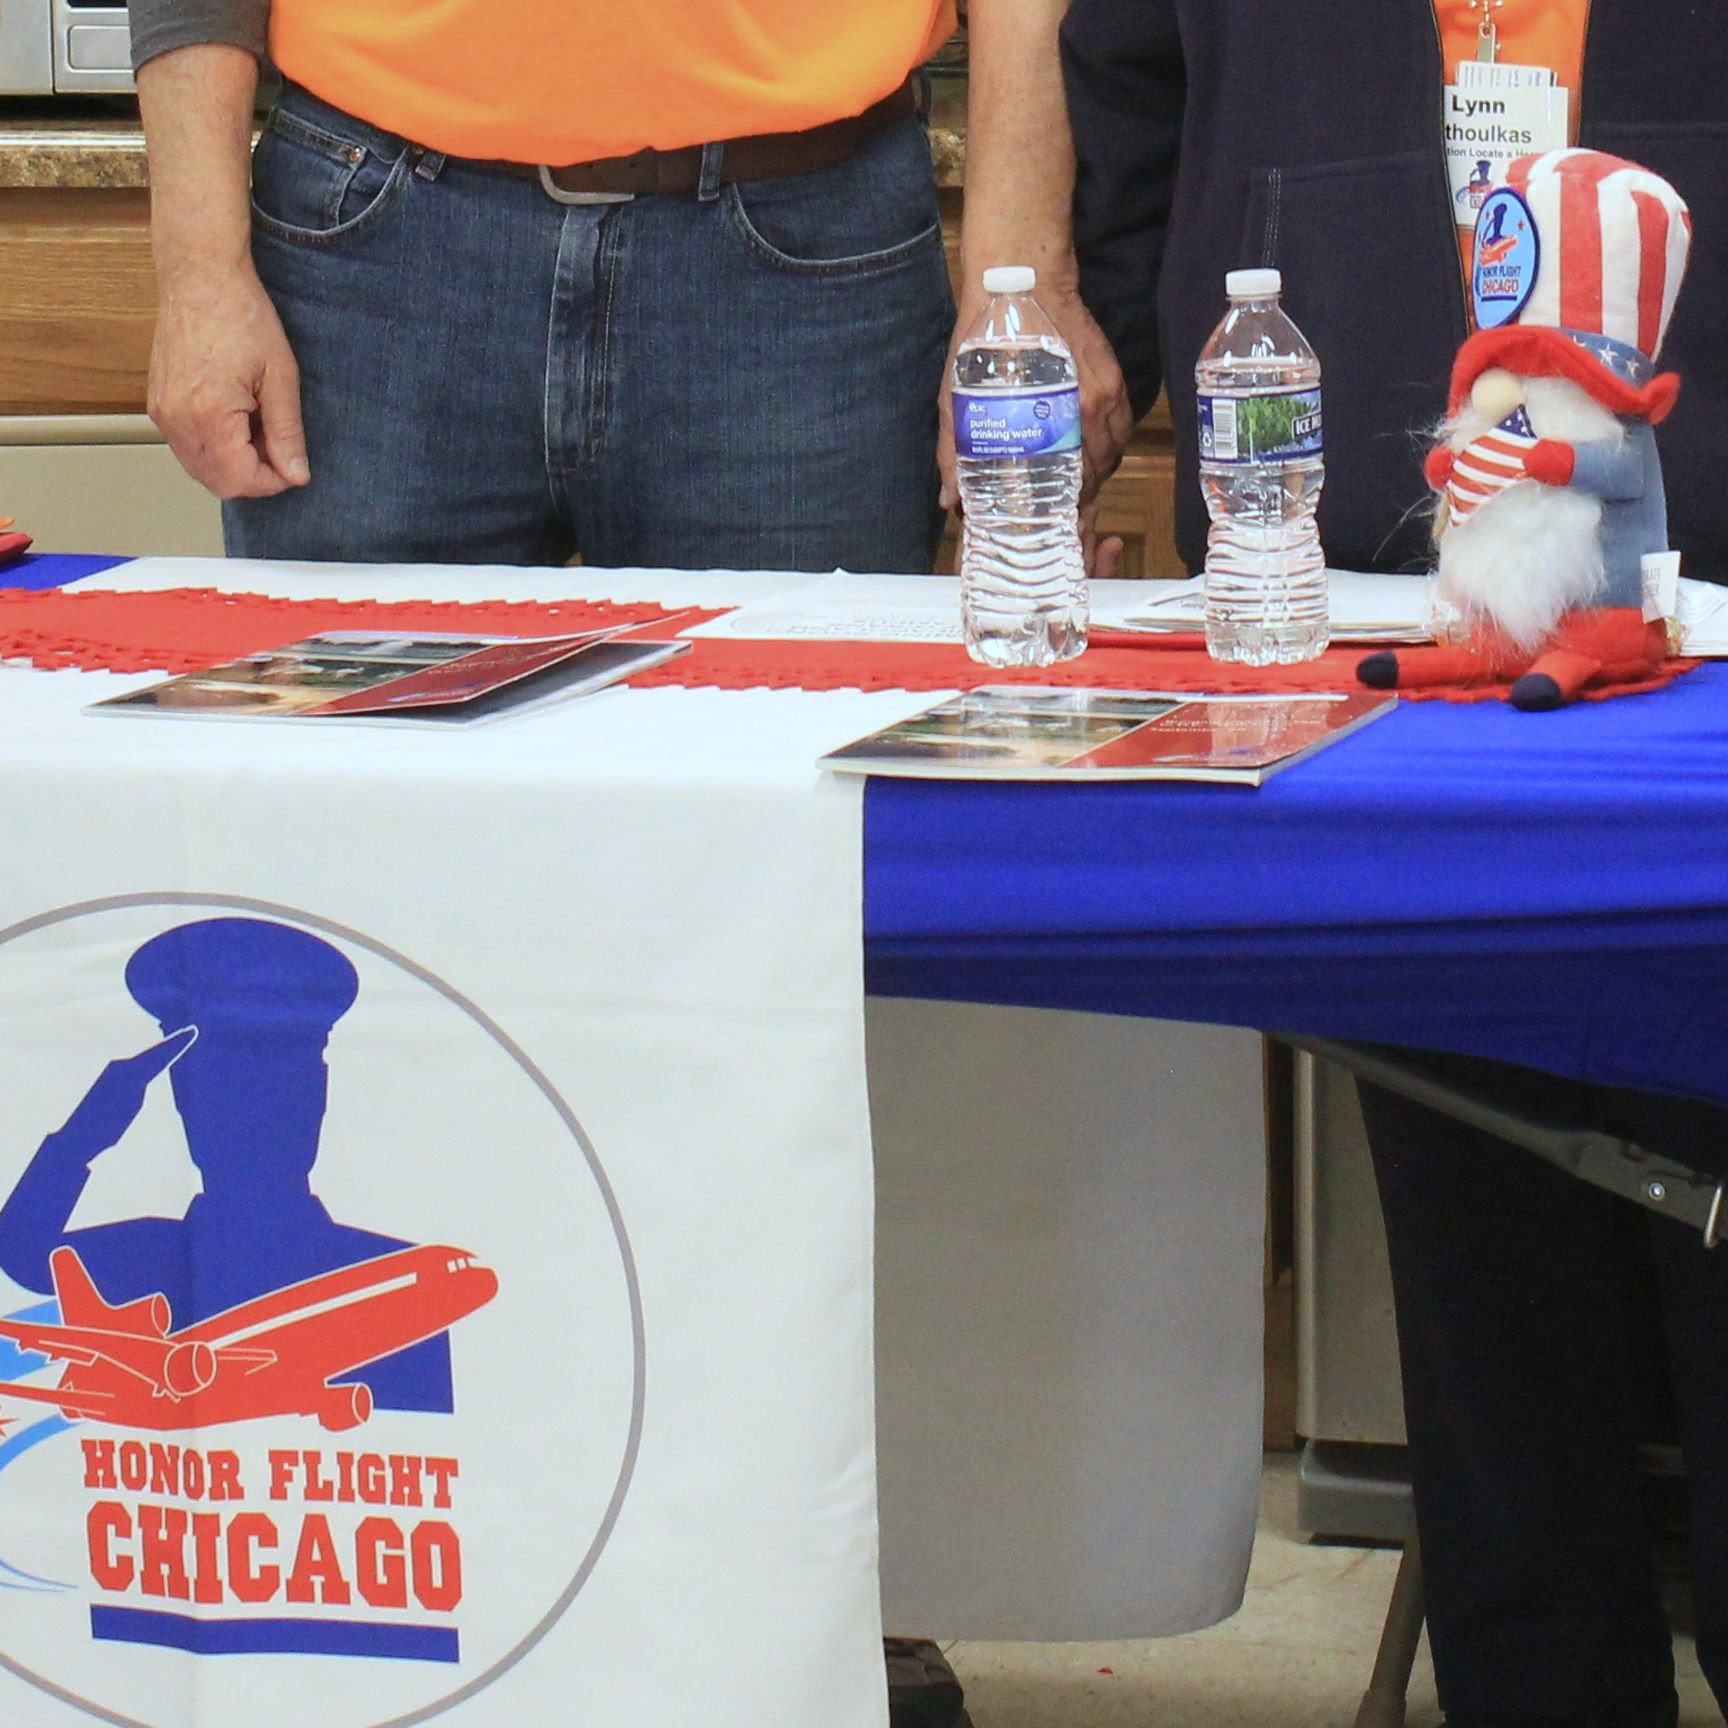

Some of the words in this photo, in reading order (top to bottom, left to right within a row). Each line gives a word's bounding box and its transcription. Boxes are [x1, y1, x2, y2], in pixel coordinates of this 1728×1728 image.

[1452, 93, 1506, 117] Lynn
[1445, 123, 1533, 144] thoulkas
[1468, 147, 1504, 159] Locate
[969, 418, 1007, 430] purified
[1294, 417, 1311, 436] ICE
[970, 429, 1010, 442] drinking
[1011, 428, 1043, 439] water
[81, 1439, 244, 1501] HONOR
[268, 1449, 459, 1509] FLIGHT
[87, 1500, 462, 1612] CHICAGO
